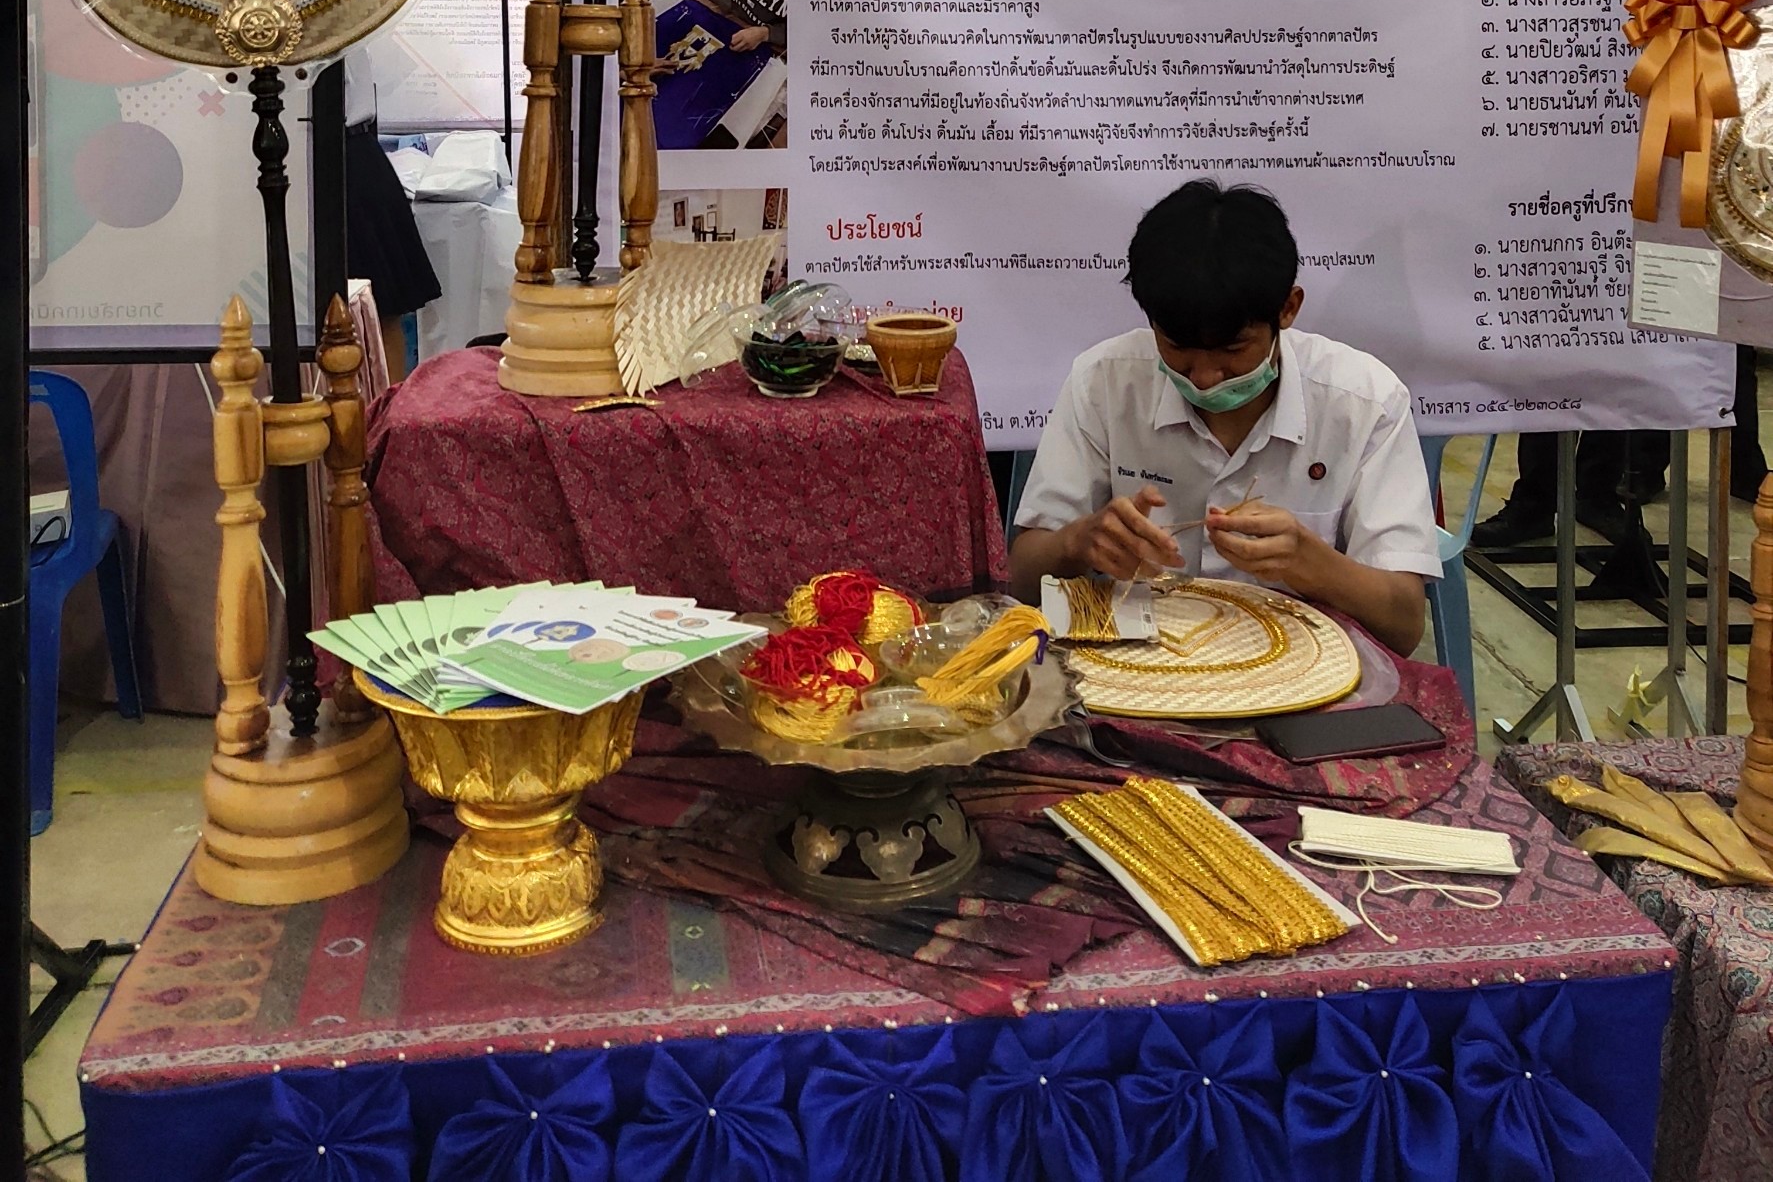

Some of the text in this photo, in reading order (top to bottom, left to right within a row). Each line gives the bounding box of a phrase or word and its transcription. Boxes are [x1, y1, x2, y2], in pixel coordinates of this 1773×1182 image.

[1481, 21, 1499, 33] ๓.
[1505, 17, 1621, 41] นางสาวสุรชนา
[1481, 44, 1499, 59] ๔.
[1505, 34, 1603, 59] นายปิยวัฒน์
[1161, 56, 1396, 80] จึงเกิดการพัฒนานำวัสดุในการประดิษฐ์
[1481, 70, 1500, 86] ๕.
[1505, 63, 1617, 85] นางสาวอริศรา
[1481, 96, 1500, 111] ๖.
[1505, 87, 1599, 111] นายธนนันท์
[810, 123, 834, 141] เช่น
[838, 118, 876, 140] ดิ้นข้อ
[881, 118, 932, 140] ดิ้นโปร่ง
[936, 118, 976, 141] ดิ้นมัน
[1481, 122, 1500, 137] ๗.
[1505, 112, 1605, 137] นายรชานนท์
[826, 212, 923, 241] ประโยชน์
[1474, 243, 1491, 255] ๑.
[1497, 237, 1585, 254] นายกนกกร
[804, 251, 1129, 274] ตาลปัตรใช้สำหรับพระสงฆ์ในงานพิธีและถวายเป็นเค
[1473, 262, 1491, 279] ๒.
[1497, 252, 1608, 280] นางสาวจามจุรี
[1473, 290, 1491, 302] ๓.
[1496, 273, 1599, 302] นายอาทินันท์
[1475, 311, 1493, 327] ๔.
[1497, 302, 1614, 326] นางสาวฉันทนา
[1478, 335, 1495, 351] ๕.
[1500, 326, 1625, 350] นางสาวฉวีวรรณ
[1417, 396, 1471, 416] โทรสาร
[981, 411, 1004, 430] ธิน
